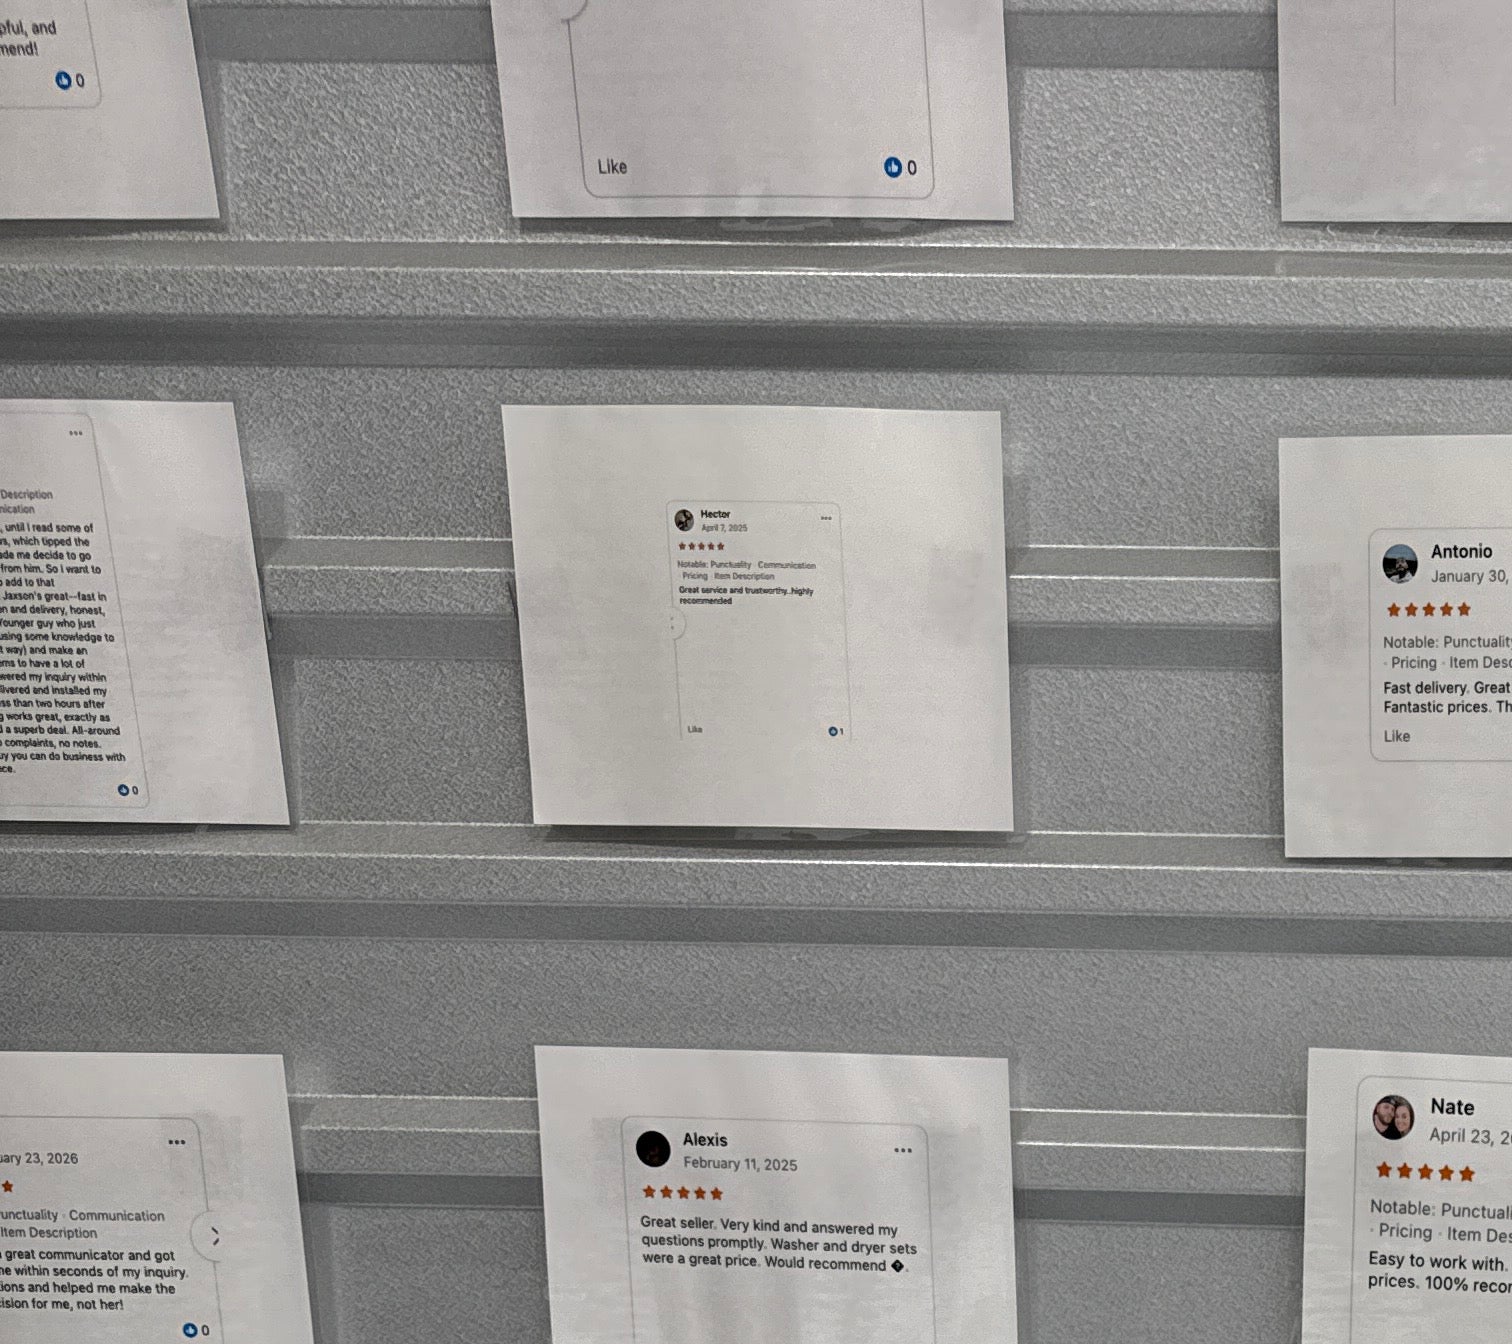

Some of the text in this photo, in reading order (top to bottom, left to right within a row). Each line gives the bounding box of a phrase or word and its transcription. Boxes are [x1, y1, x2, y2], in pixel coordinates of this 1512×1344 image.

[31, 19, 57, 35] and
[75, 72, 85, 88] 0
[597, 158, 628, 175] Like
[907, 159, 917, 176] 0
[4, 521, 26, 533] until
[31, 522, 54, 533] read
[55, 524, 82, 533] some
[83, 522, 94, 534] of
[1431, 542, 1493, 559] Antonio
[1431, 569, 1485, 586] January
[1488, 568, 1509, 586] 30,
[1383, 634, 1439, 649] Notable:
[1383, 681, 1412, 695] Fast
[1414, 680, 1470, 697] delivery.
[1473, 680, 1511, 694] Great
[1384, 700, 1444, 714] Fantastic
[1447, 699, 1493, 716] prices.
[5, 726, 12, 734] a
[13, 724, 46, 736] superb
[71, 725, 121, 736] All-around
[1384, 729, 1411, 743] Like
[1431, 1097, 1475, 1116] Nate
[682, 1131, 728, 1148] Alexis
[1429, 1127, 1466, 1145] April
[1470, 1128, 1495, 1148] 23,
[24, 1151, 79, 1168] 23, 2026
[683, 1155, 798, 1173] February 11, 2025
[640, 1215, 898, 1239] Great seller. Very kind and answered my
[1369, 1250, 1405, 1270] Easy
[1409, 1253, 1425, 1268] to
[1429, 1254, 1467, 1270] work
[1471, 1255, 1509, 1272] with.
[13, 1264, 189, 1281] within seconds of my inquiry.
[201, 1324, 210, 1337] 0
